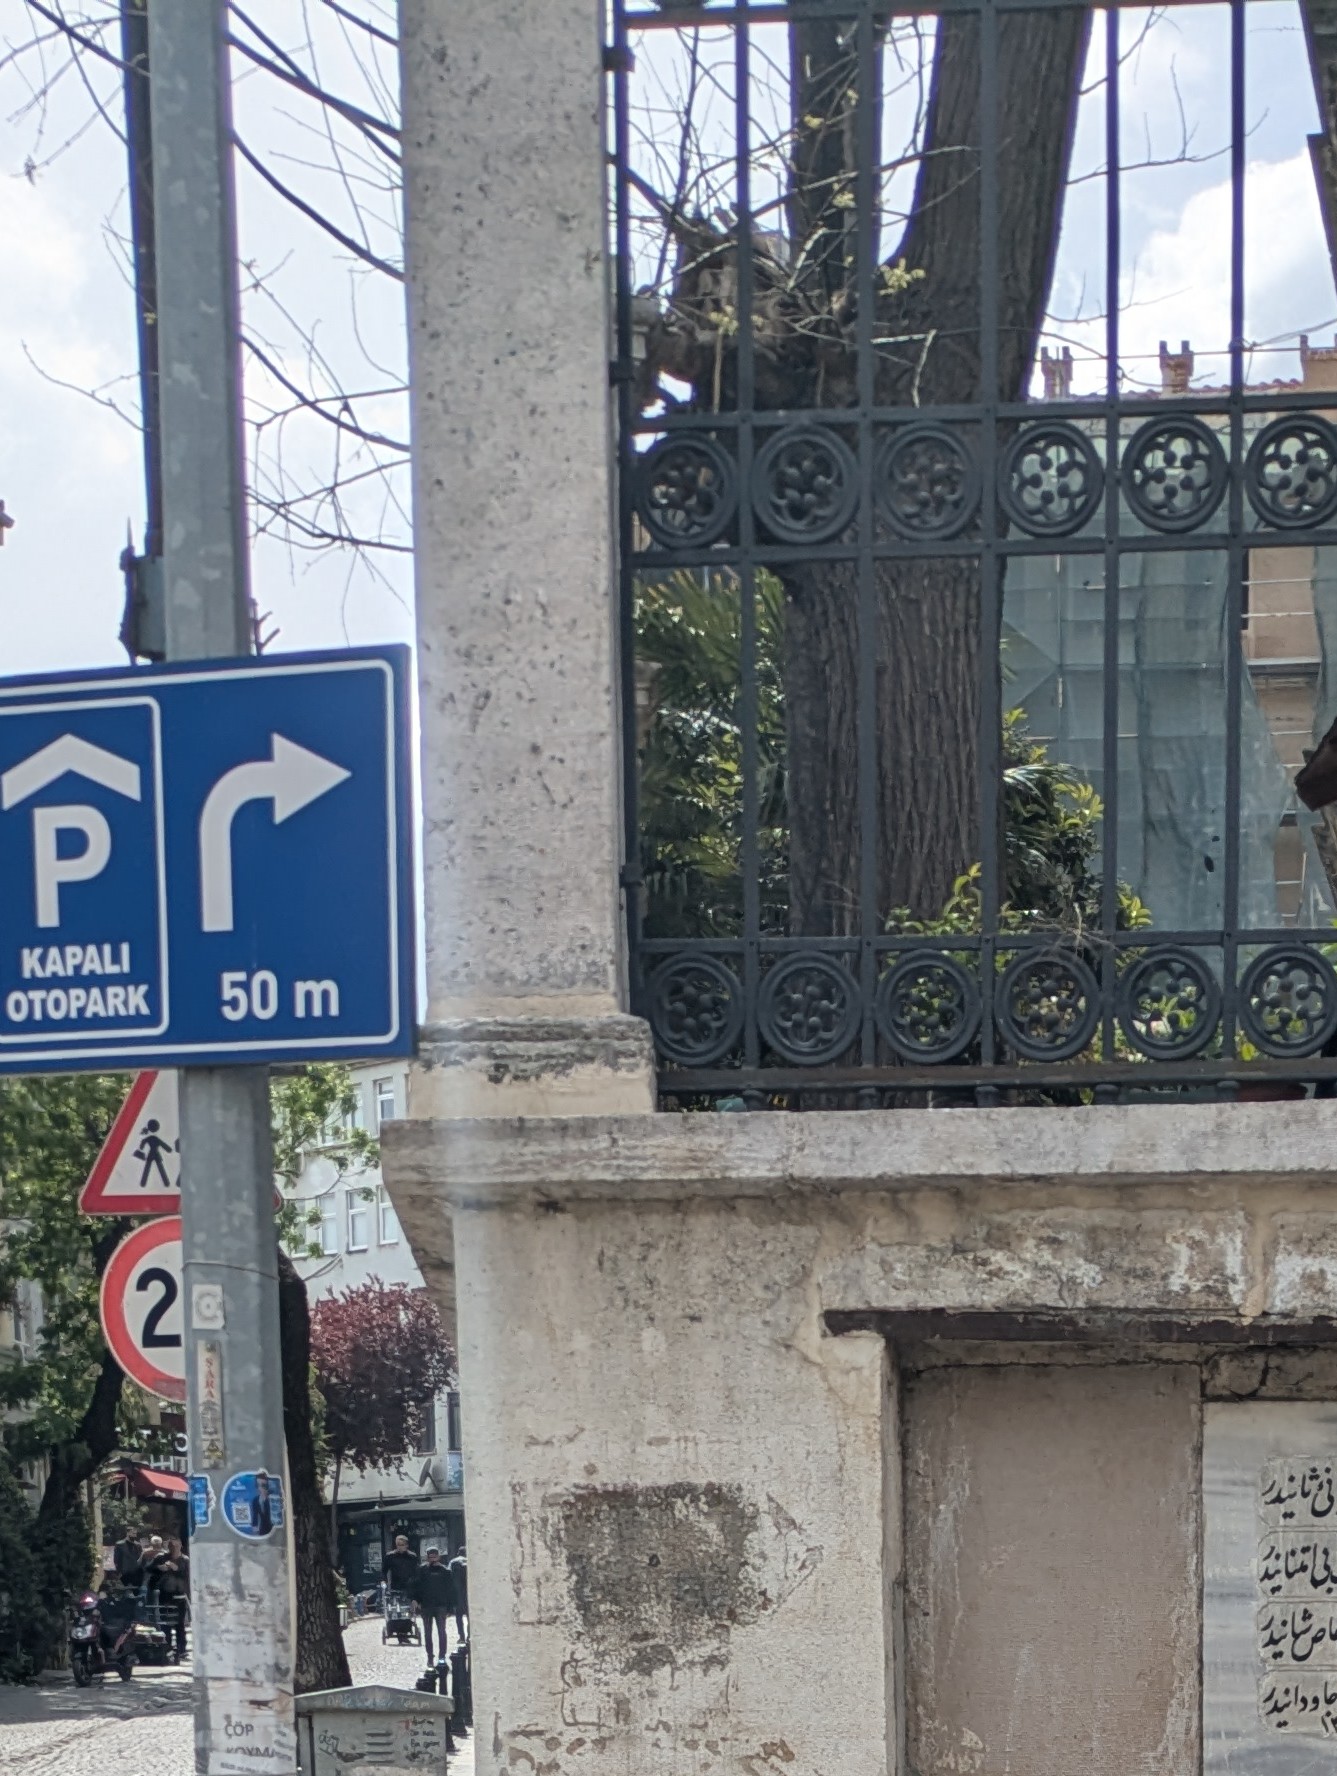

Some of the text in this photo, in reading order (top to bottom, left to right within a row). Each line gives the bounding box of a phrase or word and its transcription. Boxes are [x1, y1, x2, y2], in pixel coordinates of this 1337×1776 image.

[33, 804, 112, 929] P
[21, 942, 131, 980] KAPALI
[6, 984, 151, 1023] OTOPARK
[221, 969, 340, 1022] 50 m
